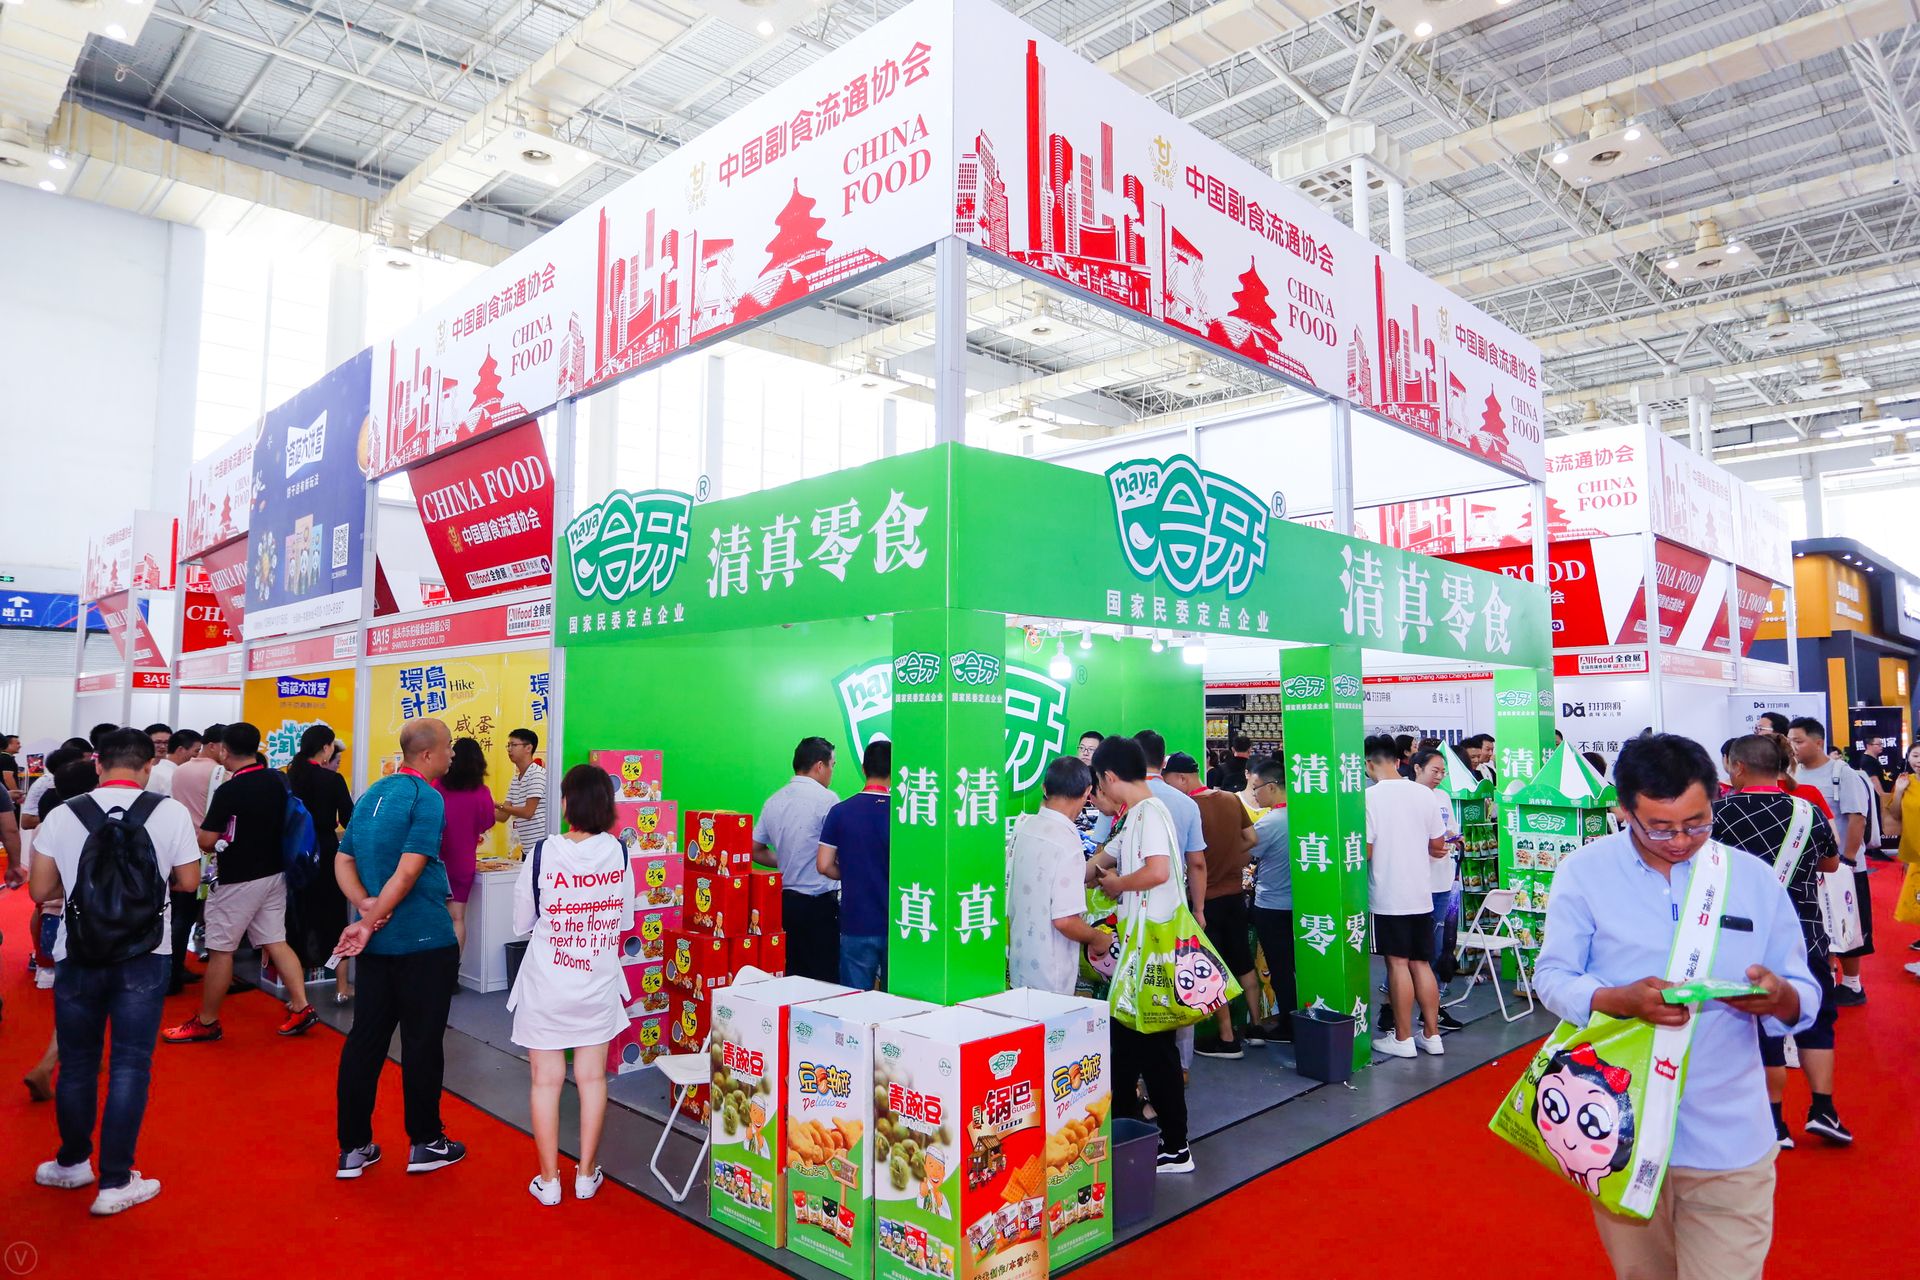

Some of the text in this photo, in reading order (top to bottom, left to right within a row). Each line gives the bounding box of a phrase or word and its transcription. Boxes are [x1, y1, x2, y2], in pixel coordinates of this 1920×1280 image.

[719, 41, 932, 188] 中国副食流通协会
[843, 113, 930, 176] CHINA
[841, 148, 932, 217] FOOD
[1185, 165, 1335, 276] 中国副食流通协会
[451, 262, 557, 342] 中国副食流通协会
[1287, 276, 1336, 319] CHINA
[512, 313, 553, 349] CHINA
[1288, 302, 1338, 347] FOOD
[510, 339, 553, 377] FOOD
[1455, 323, 1538, 390] 中国副食流通协会
[1510, 394, 1538, 423] CHINA
[1512, 416, 1540, 445] FOOD
[422, 453, 546, 524] CHINA FOOD
[1577, 476, 1635, 496] CHINA
[1578, 491, 1638, 512] FOOD
[463, 507, 542, 548] 中国副食流通协会
[706, 487, 929, 599] 清真零食
[1117, 455, 1268, 594] 哈牙
[572, 490, 694, 601] 哈牙
[1339, 544, 1512, 656] 清真零食
[1675, 570, 1702, 594] FOOD
[2, 608, 33, 618] 出口
[186, 604, 223, 623] CH
[569, 602, 685, 635] 国家民委定点企业
[1106, 589, 1269, 633] 国家民委定点企业
[372, 629, 390, 646] 3A15
[143, 674, 171, 684] 3A19
[400, 665, 447, 696] 環島
[449, 679, 475, 693] Hike
[401, 690, 447, 720] 計劃
[895, 766, 940, 943] 清真
[954, 766, 1000, 944] 清真
[1291, 752, 1338, 1014] 清真零
[549, 898, 562, 915] of
[550, 915, 621, 933] to the flower
[549, 935, 574, 949] next
[576, 934, 587, 948] to
[590, 933, 597, 948] it
[600, 932, 607, 947] it
[723, 1041, 764, 1078] 青豌豆
[802, 1096, 847, 1112] Delicious
[888, 1082, 942, 1127] 青豌豆
[985, 1080, 1031, 1126] 锅巴
[1012, 1101, 1036, 1115] GUOBA
[1056, 1083, 1098, 1119] Delicious
